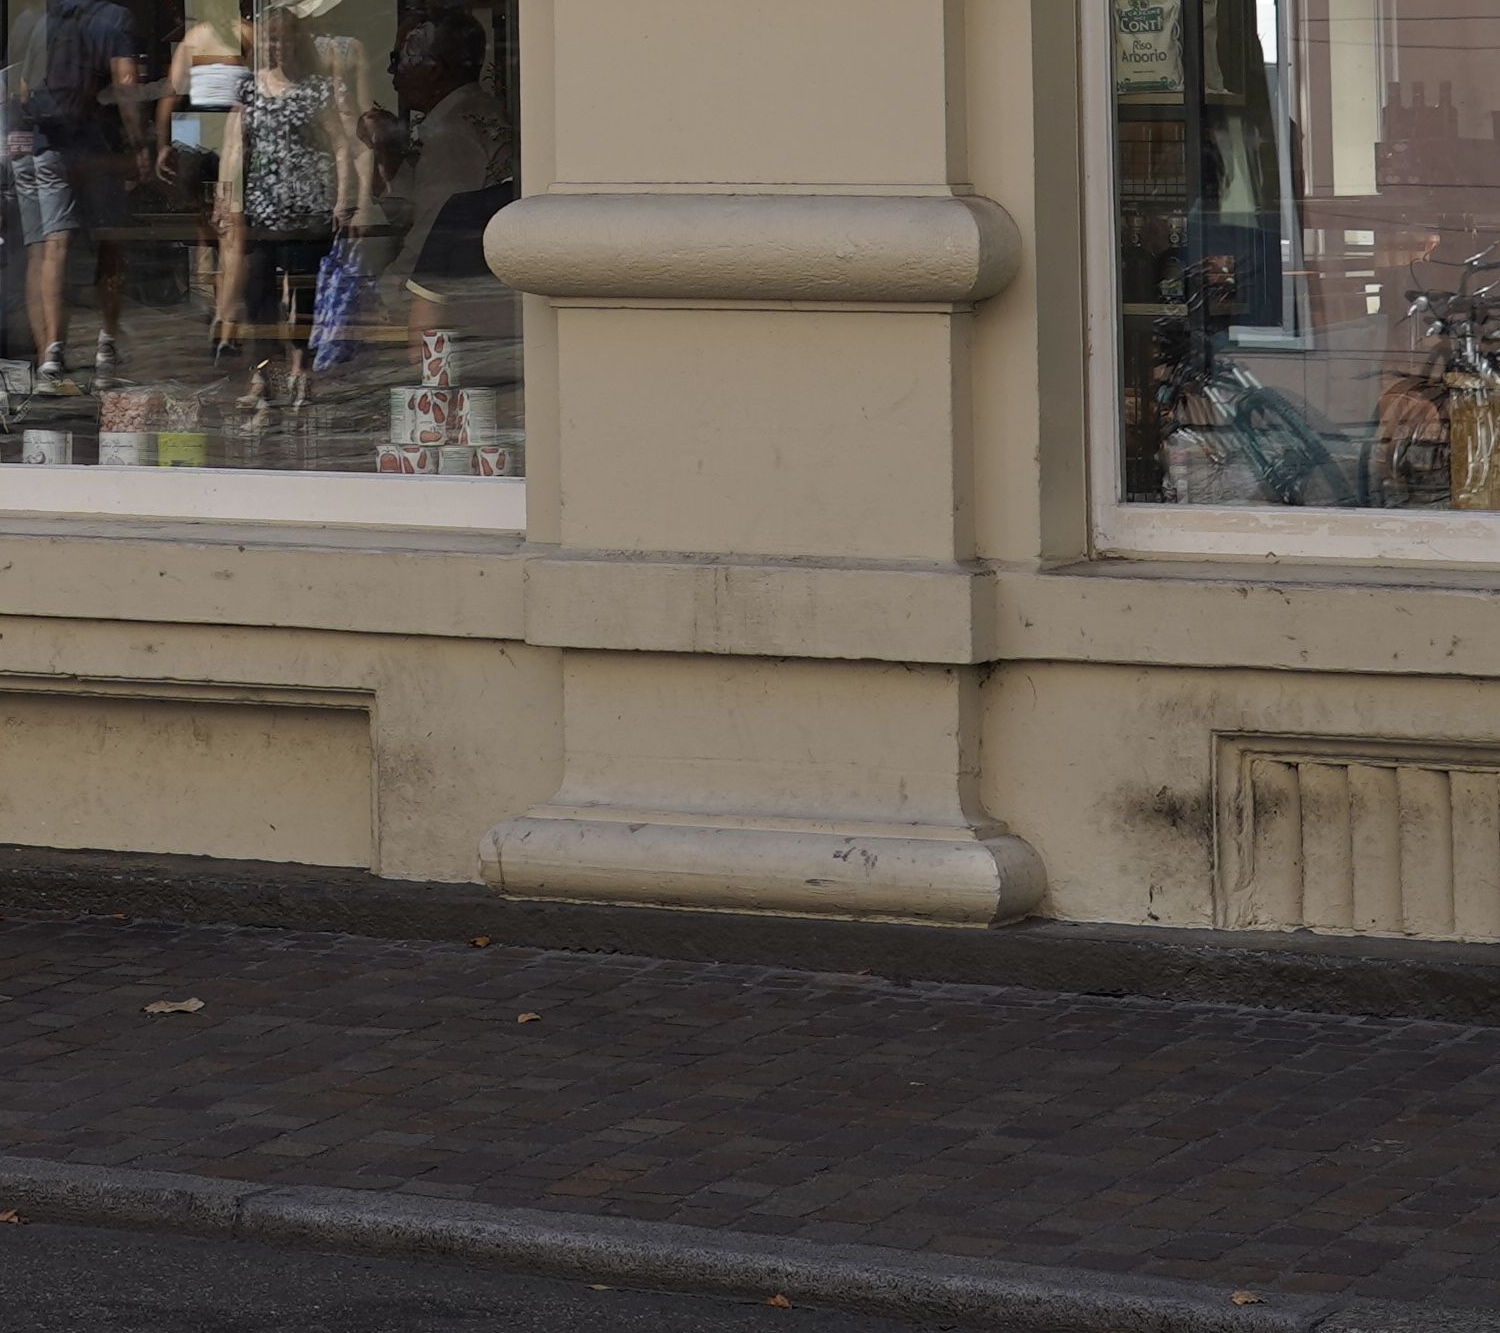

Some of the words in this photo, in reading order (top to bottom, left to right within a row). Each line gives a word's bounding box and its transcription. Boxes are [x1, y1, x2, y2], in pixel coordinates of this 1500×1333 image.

[1120, 16, 1163, 32] CONTI
[1133, 40, 1153, 53] Riso
[1121, 49, 1168, 63] Arborio
